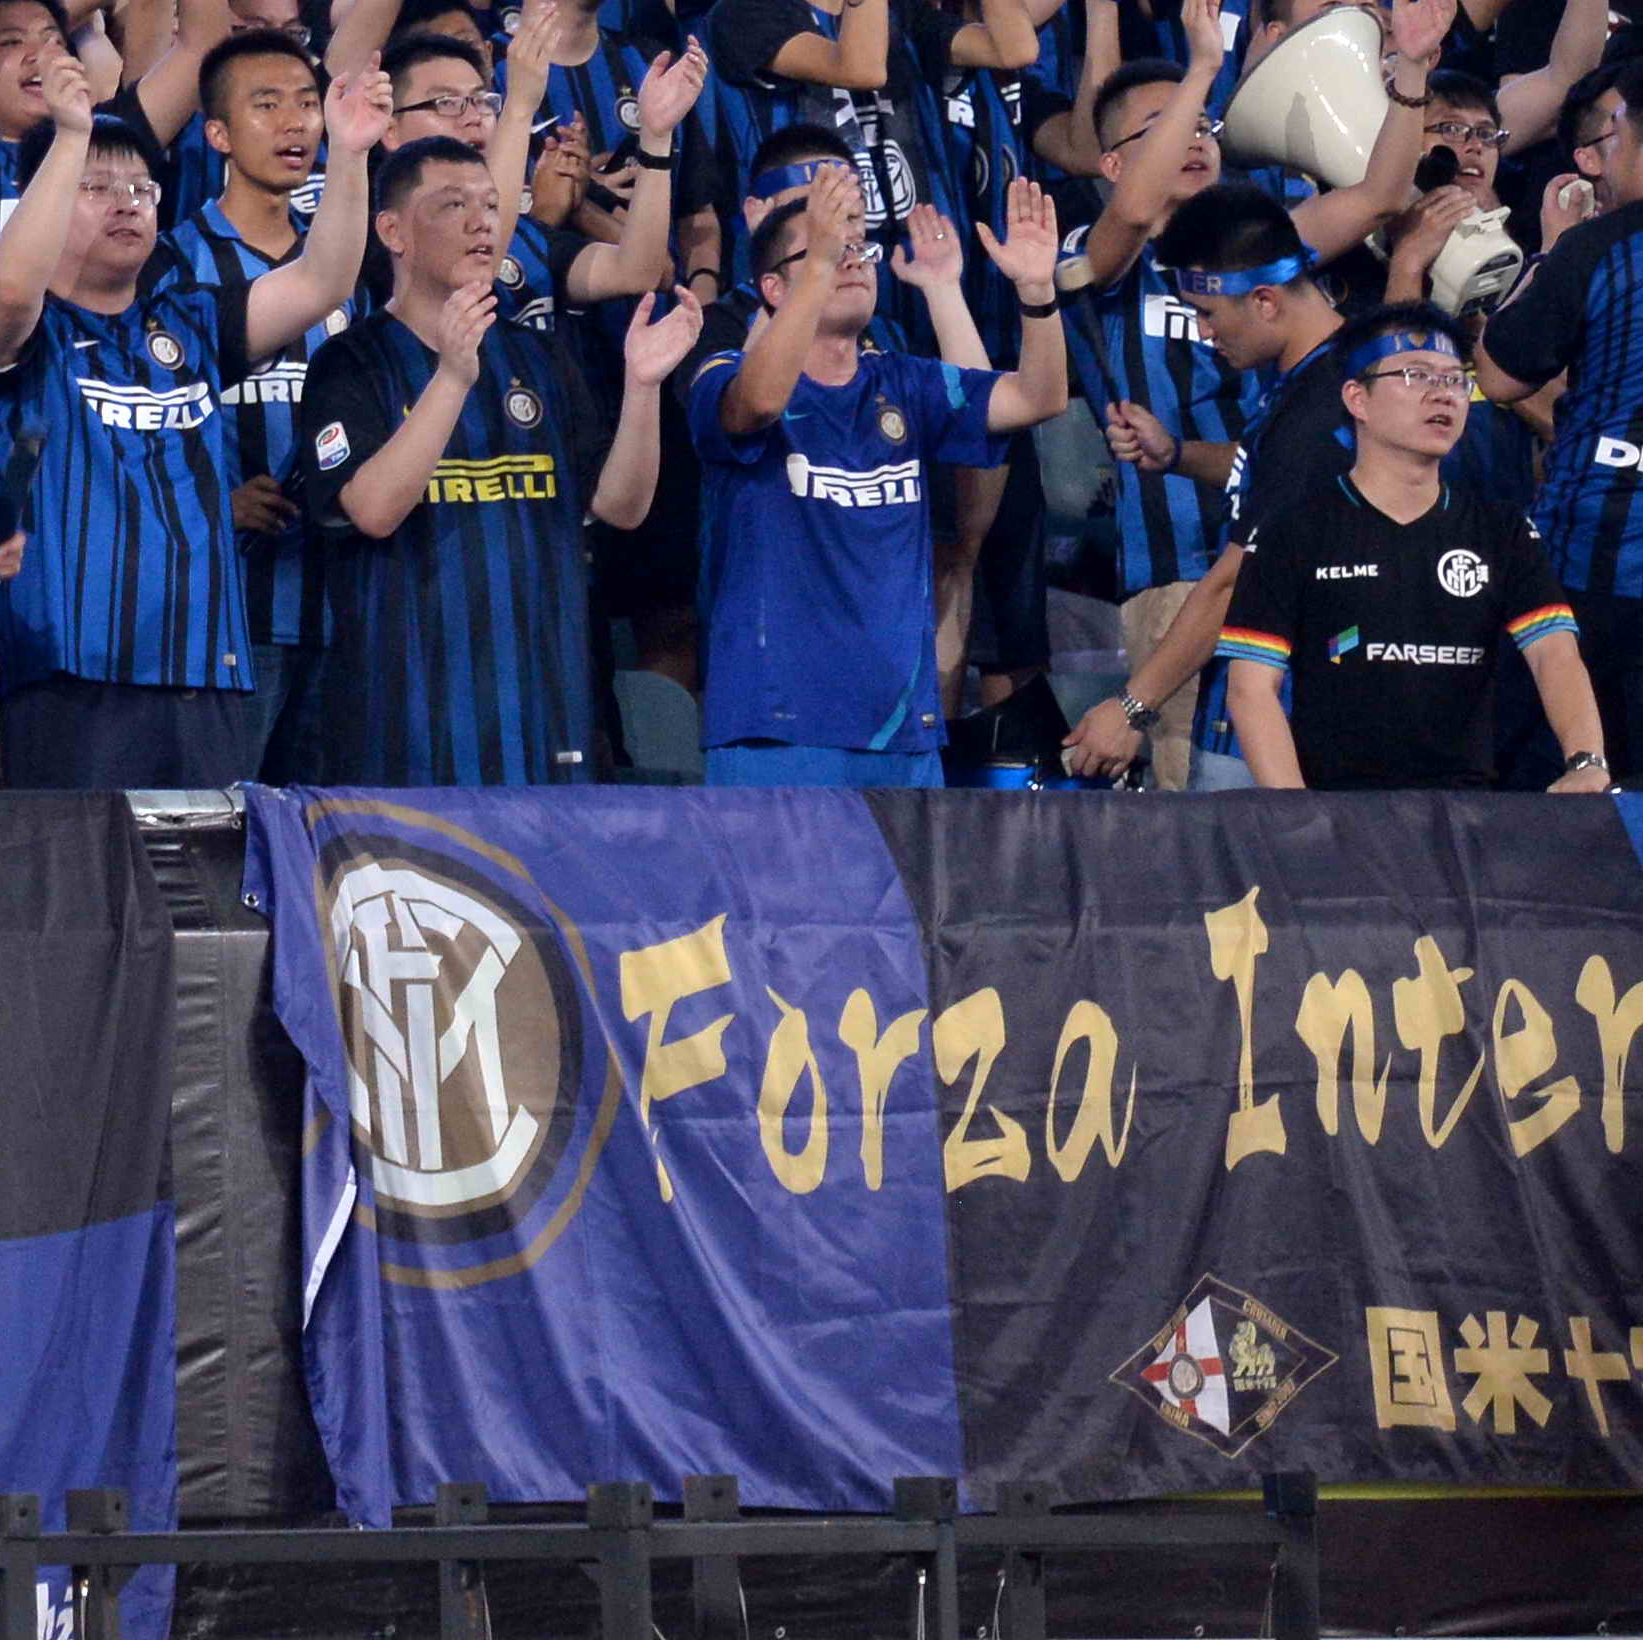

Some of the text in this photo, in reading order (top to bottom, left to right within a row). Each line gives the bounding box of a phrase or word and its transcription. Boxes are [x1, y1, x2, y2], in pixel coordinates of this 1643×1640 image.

[429, 455, 556, 504] IRELLI
[1315, 564, 1379, 581] KELME
[618, 885, 1643, 1203] Forza Inter
[1365, 1306, 1643, 1438] 国米十
